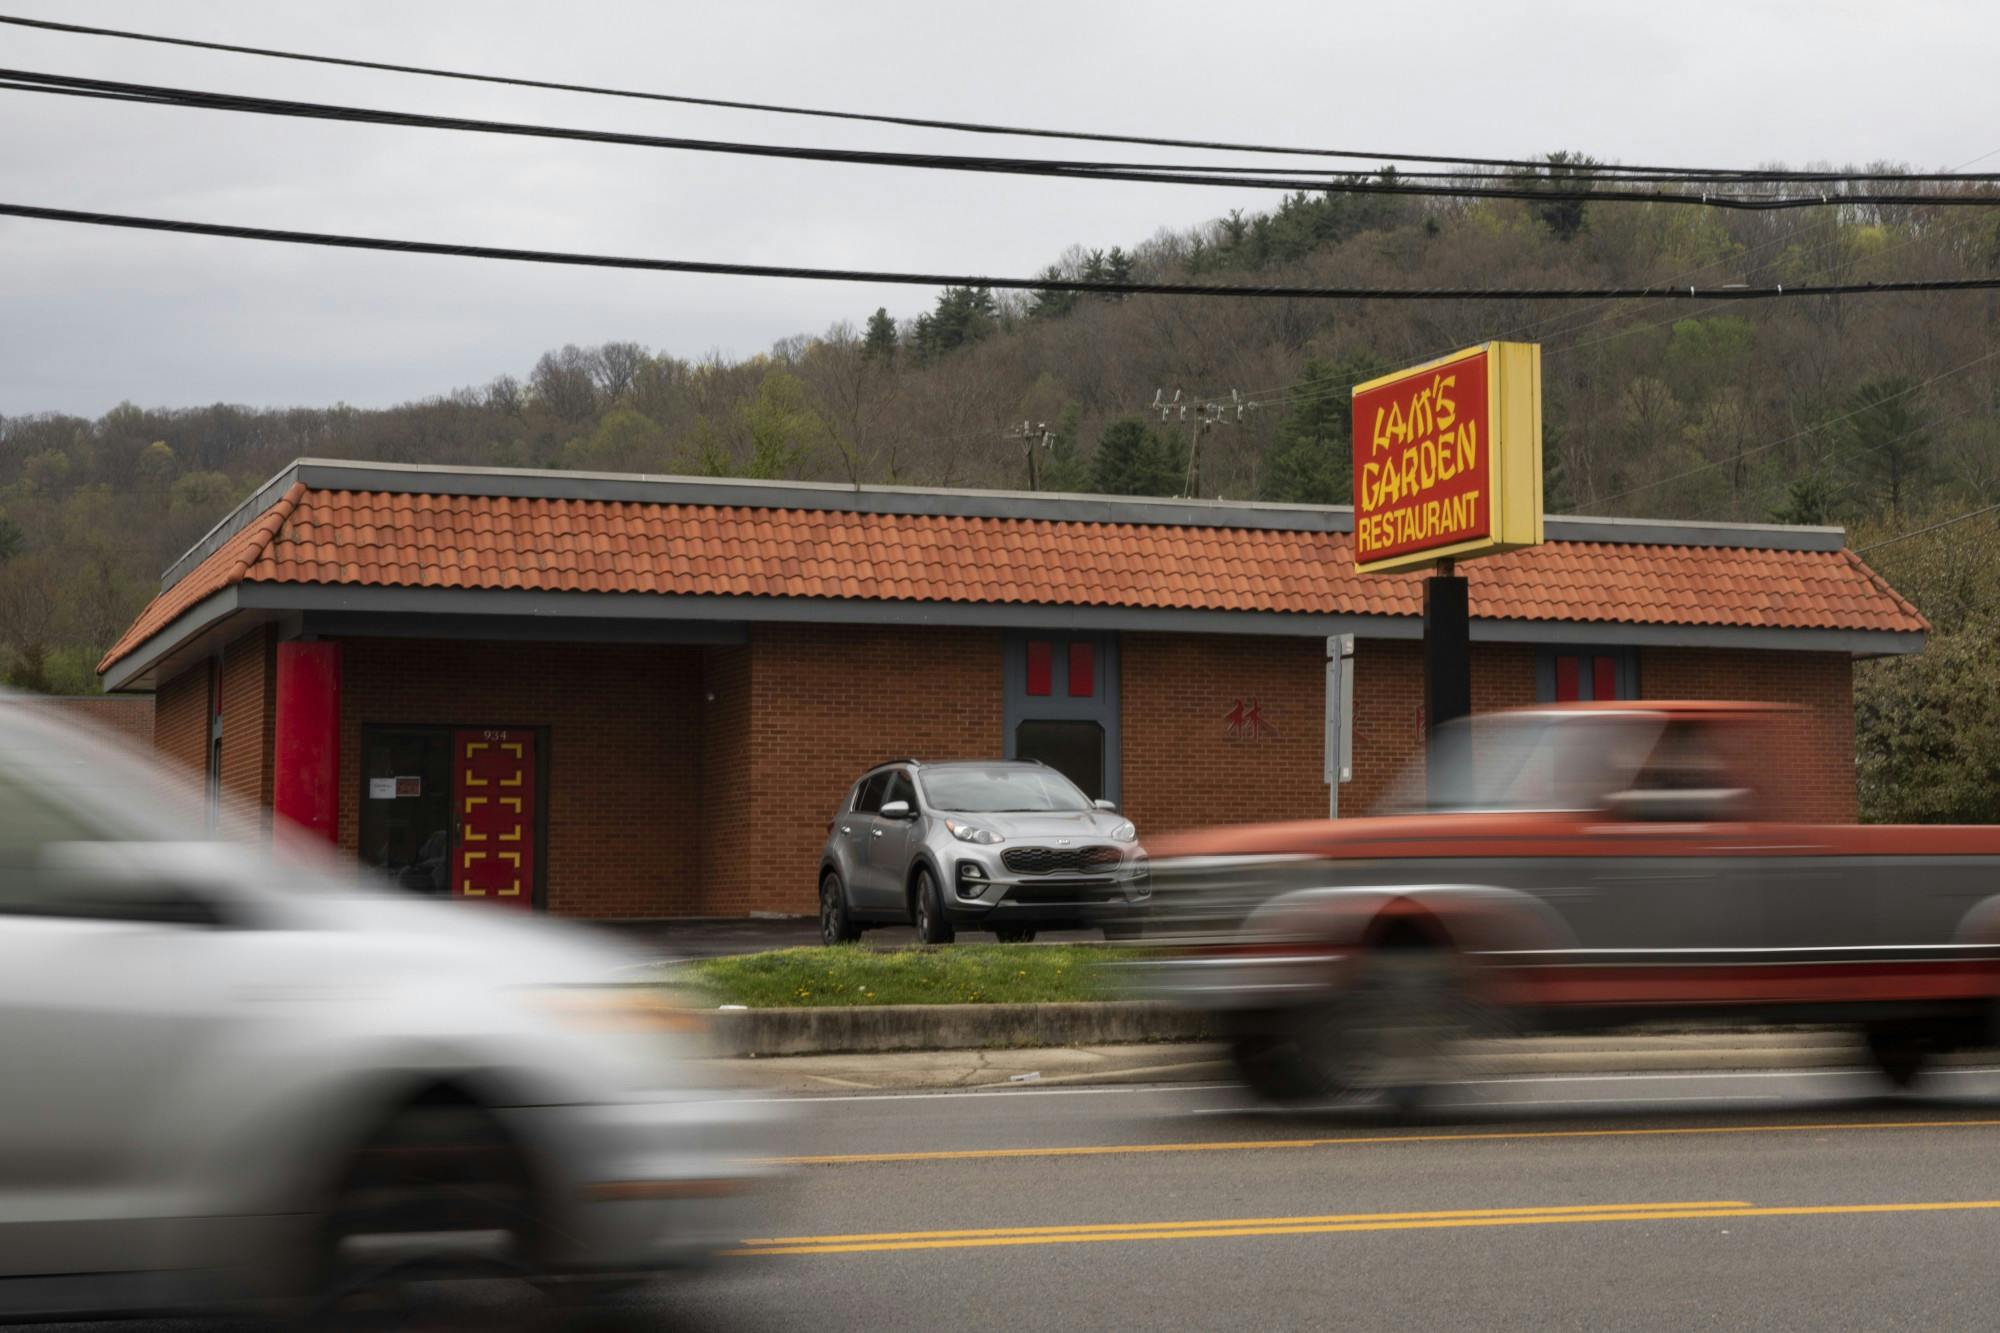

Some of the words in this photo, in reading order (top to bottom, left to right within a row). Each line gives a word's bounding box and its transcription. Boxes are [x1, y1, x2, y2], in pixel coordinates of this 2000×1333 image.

[1372, 374, 1456, 456] LAM'S
[1361, 419, 1477, 512] GARDEN
[1358, 490, 1480, 553] RESTAURANT
[483, 730, 506, 740] 934
